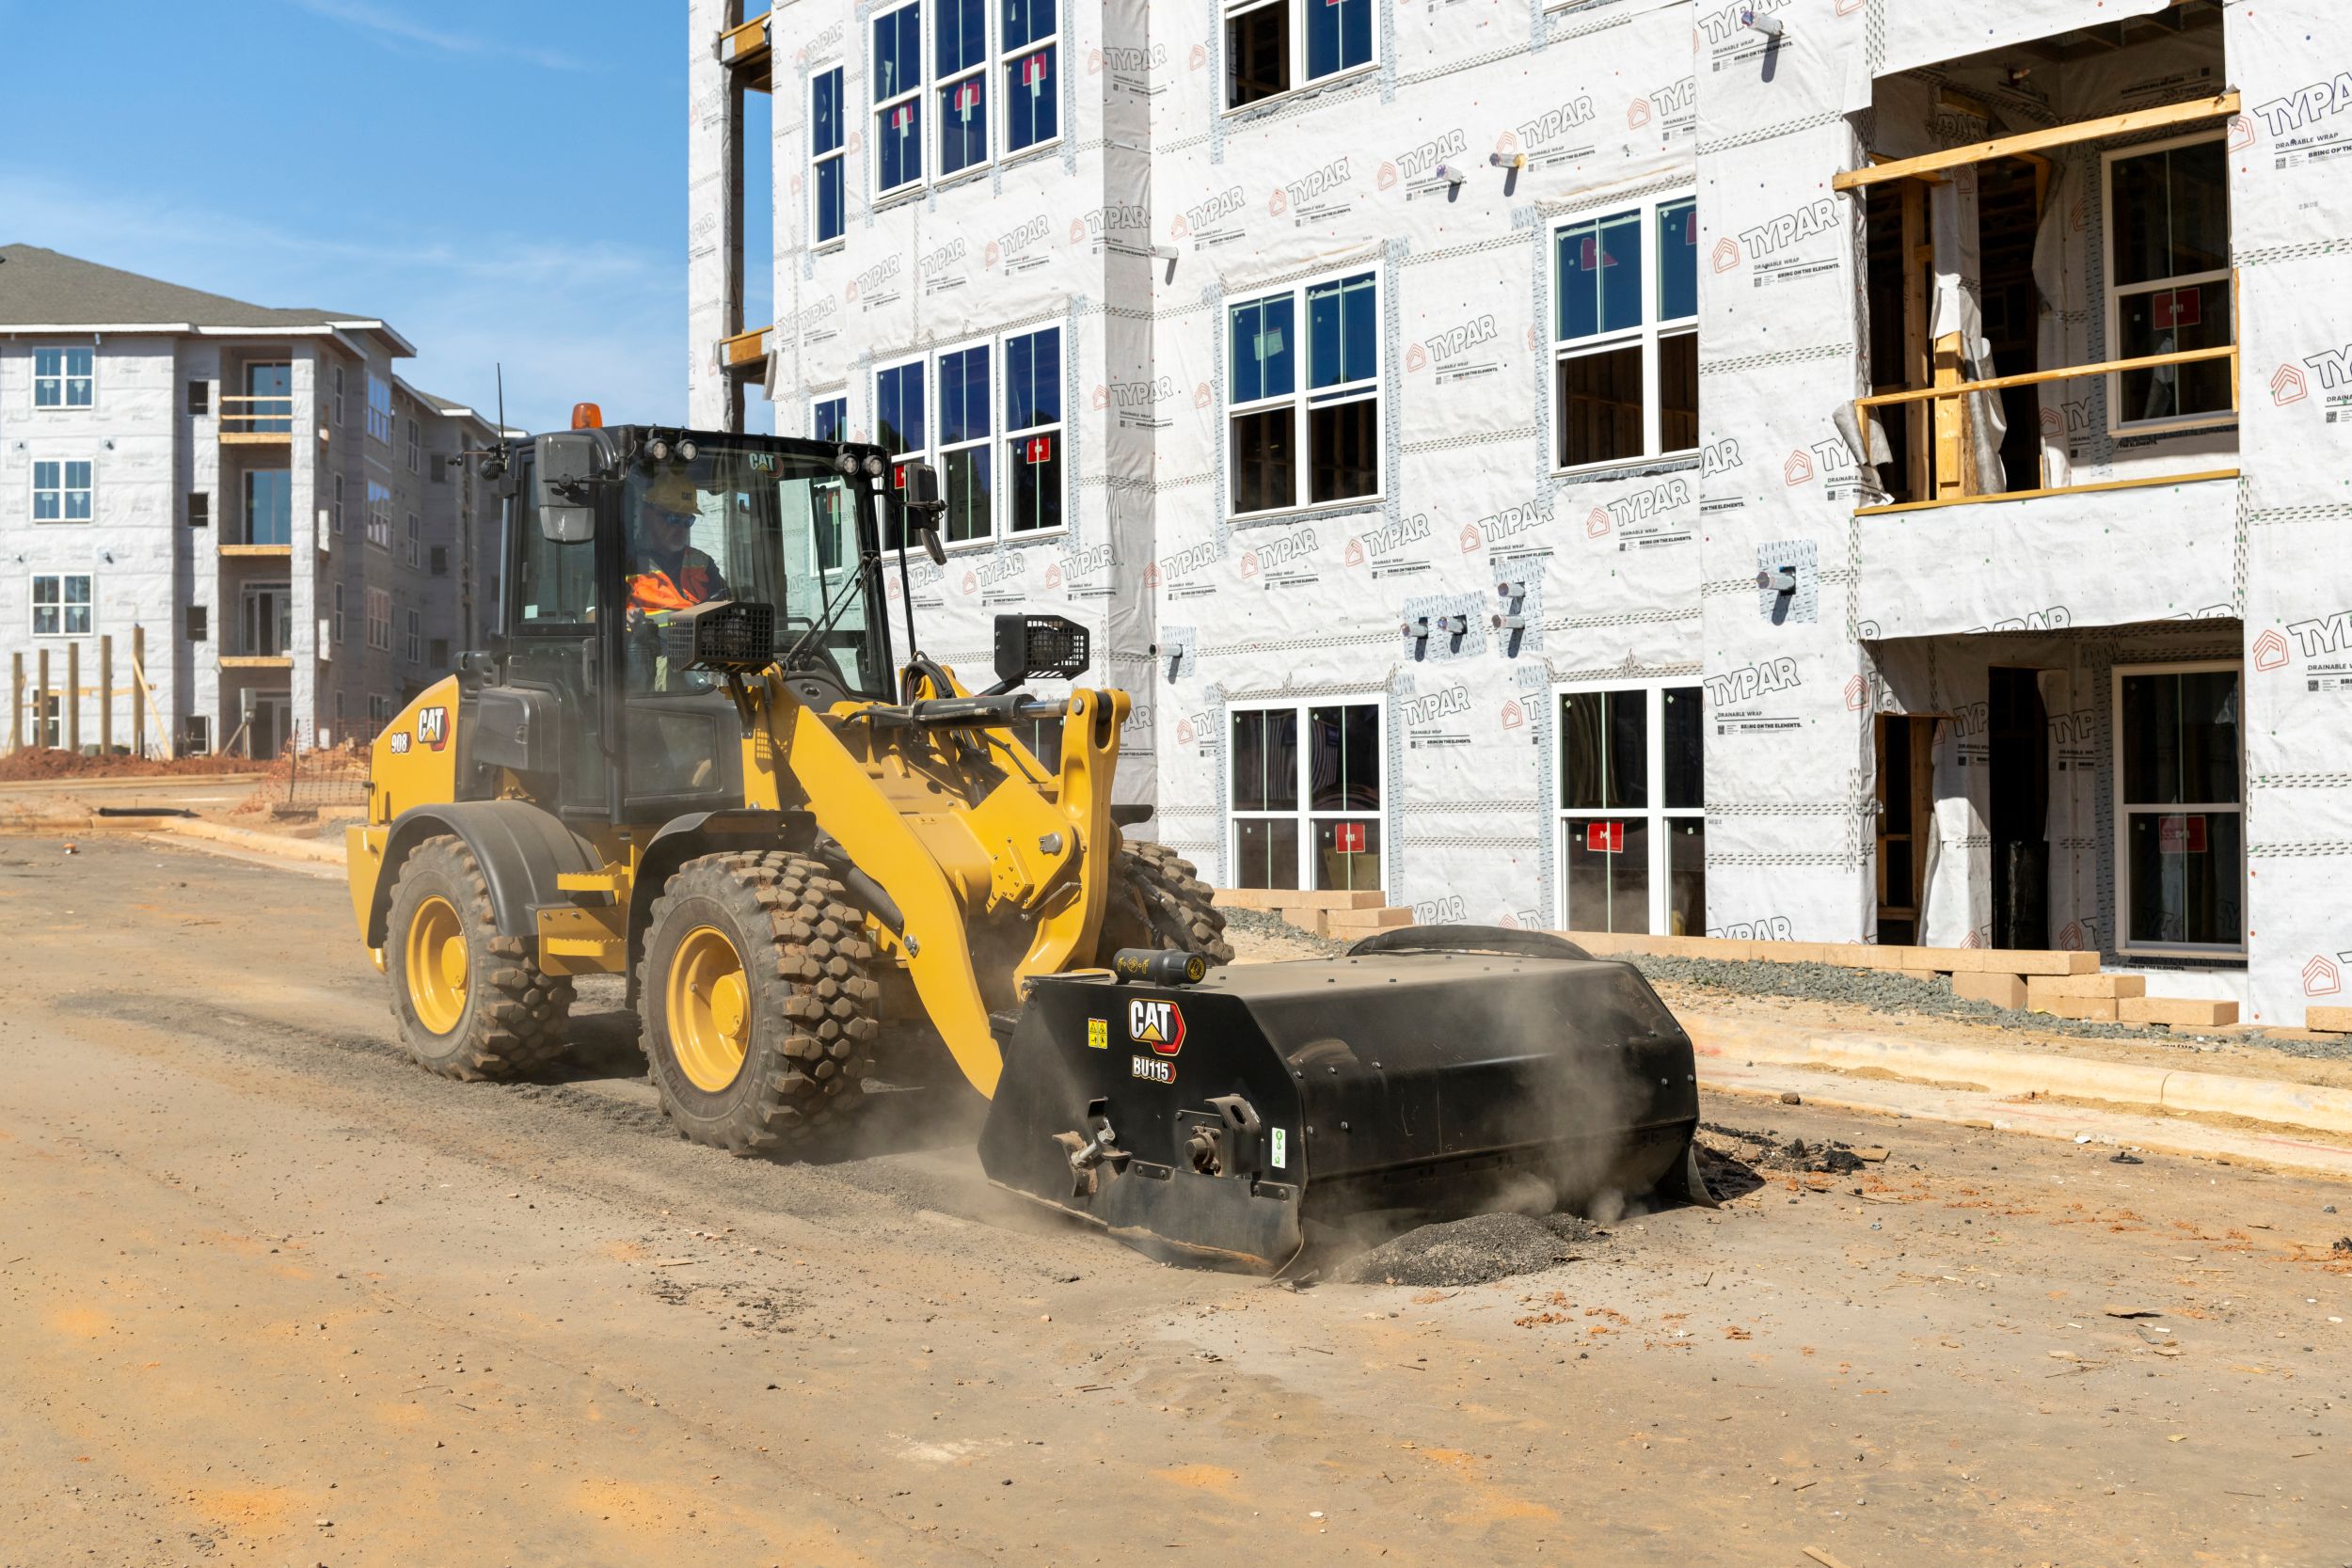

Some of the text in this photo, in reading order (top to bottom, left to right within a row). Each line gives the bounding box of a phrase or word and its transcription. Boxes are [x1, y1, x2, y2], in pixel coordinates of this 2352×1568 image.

[1698, 0, 1791, 44] TYPA
[1104, 43, 1167, 71] TYPAR
[1712, 39, 1755, 55] DRAINABLE WRAP
[1649, 75, 1695, 116] TYP
[1517, 95, 1596, 149] TYPAR
[1662, 117, 1688, 125] DRAINABLE
[2316, 133, 2339, 142] WRAP
[1396, 129, 1467, 179] TYPAR
[1529, 149, 1550, 157] DRAINABLE
[2308, 149, 2330, 158] BRING
[1286, 158, 1351, 205] TYPAR
[1085, 206, 1150, 233] TYPAR
[1186, 185, 1246, 230] TYPAR
[998, 214, 1049, 256] TYPAR
[1739, 198, 1839, 259] TYPAR
[857, 255, 900, 293] TYPAR
[920, 238, 966, 277] TYPAR
[1754, 261, 1782, 270] DRAINABLE
[1812, 263, 1840, 273] ELEMENTS.
[1425, 314, 1497, 361] TYPAR
[1109, 376, 1173, 406] TYPAR
[2327, 393, 2352, 403] DRAIN
[1607, 479, 1690, 527] TYPAR
[1718, 501, 1745, 510] ELEMENTS.
[1256, 529, 1318, 569] TYPAR
[1361, 514, 1431, 557] TYPAR
[1060, 544, 1117, 581] TYPAR
[1160, 542, 1216, 579] TYPAR
[1703, 657, 1801, 706] TYPAR
[1401, 686, 1470, 725] TYPAR
[1953, 702, 1990, 737] TYP
[391, 734, 407, 753] 908
[419, 708, 443, 742] CAT
[2048, 708, 2094, 744] TYP
[1406, 895, 1466, 926] YPAR
[1130, 1000, 1171, 1042] CAT
[1133, 1056, 1168, 1081] BU115
